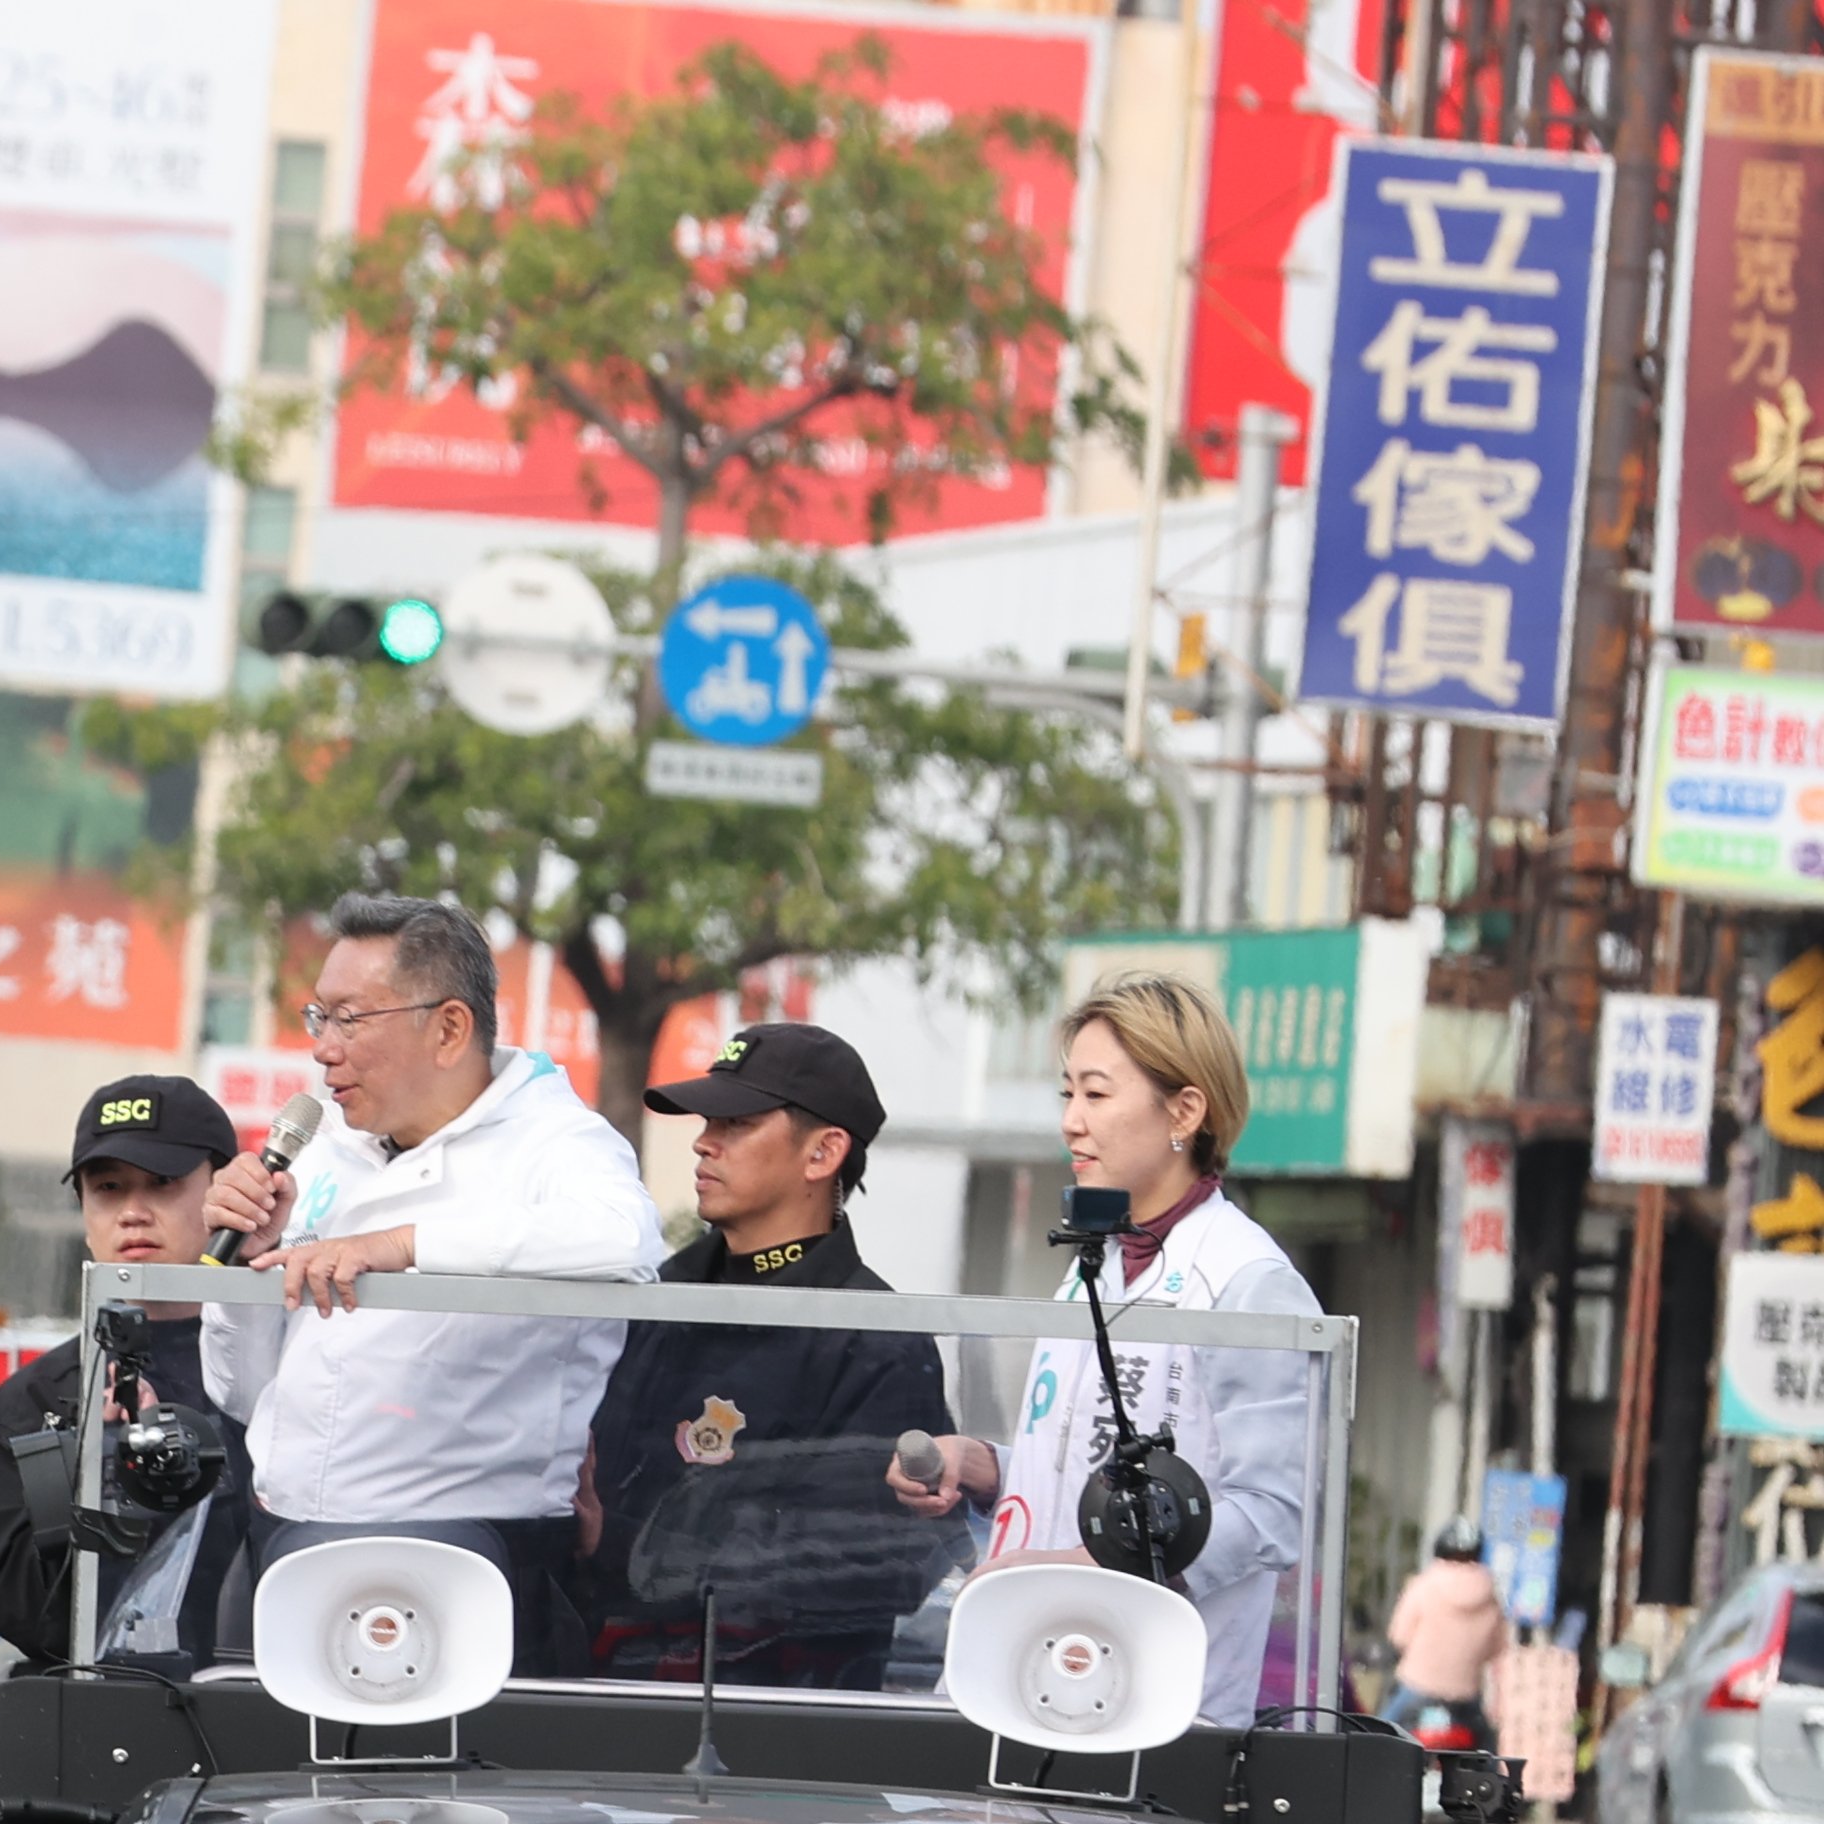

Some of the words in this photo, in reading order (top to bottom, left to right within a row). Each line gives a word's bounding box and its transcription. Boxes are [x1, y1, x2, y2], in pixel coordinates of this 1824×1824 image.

[1339, 169, 1564, 707] 立佑傢俱
[753, 1243, 803, 1274] SSC
